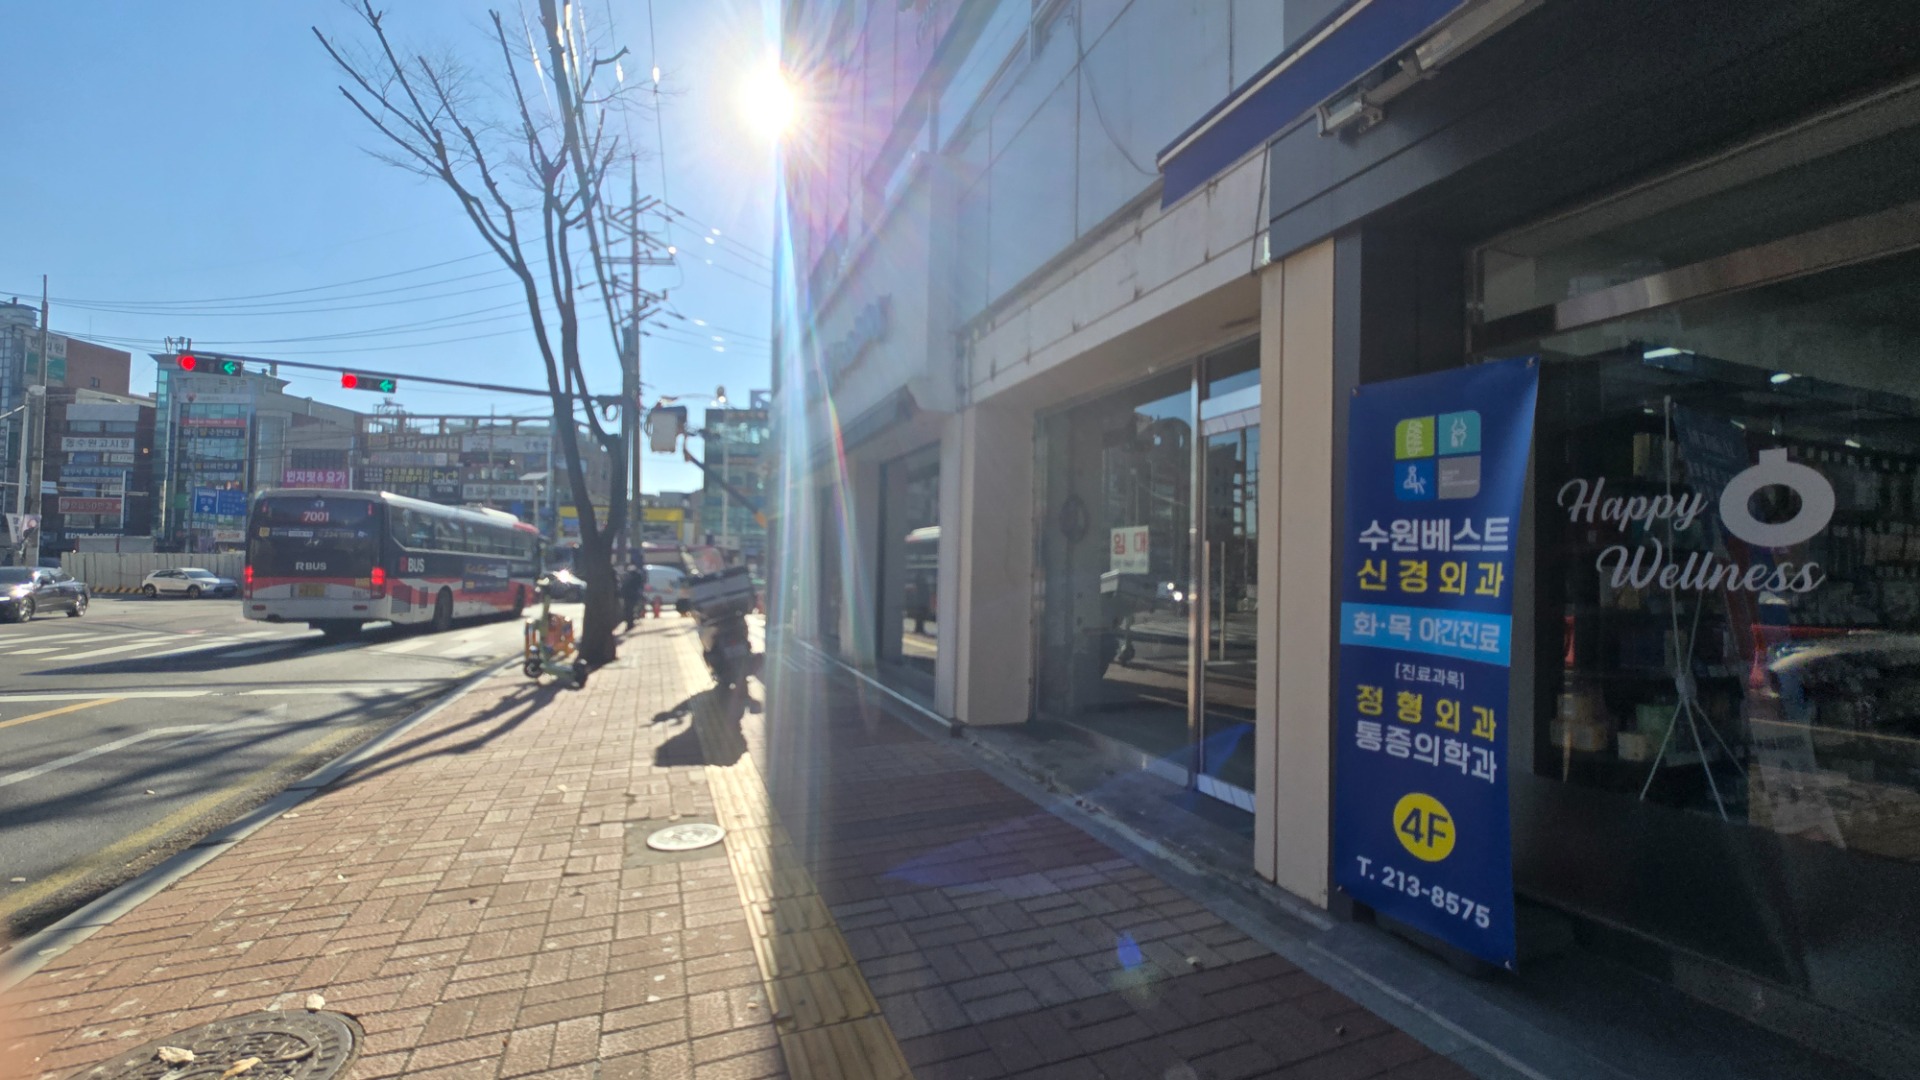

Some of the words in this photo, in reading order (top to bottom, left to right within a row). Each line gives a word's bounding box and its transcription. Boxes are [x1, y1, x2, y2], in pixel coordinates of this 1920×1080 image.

[303, 511, 330, 522] 7001
[1557, 477, 1708, 532] Happy
[1359, 516, 1510, 553] 수원베스트
[1595, 537, 1826, 594] Wellness
[1418, 616, 1501, 653] 야간진료
[1394, 662, 1465, 690] [진료과목]
[1355, 719, 1498, 784] 통증의학과
[1400, 807, 1449, 849] 4F
[1356, 855, 1376, 882] T.
[1381, 865, 1491, 929] 213-8575
